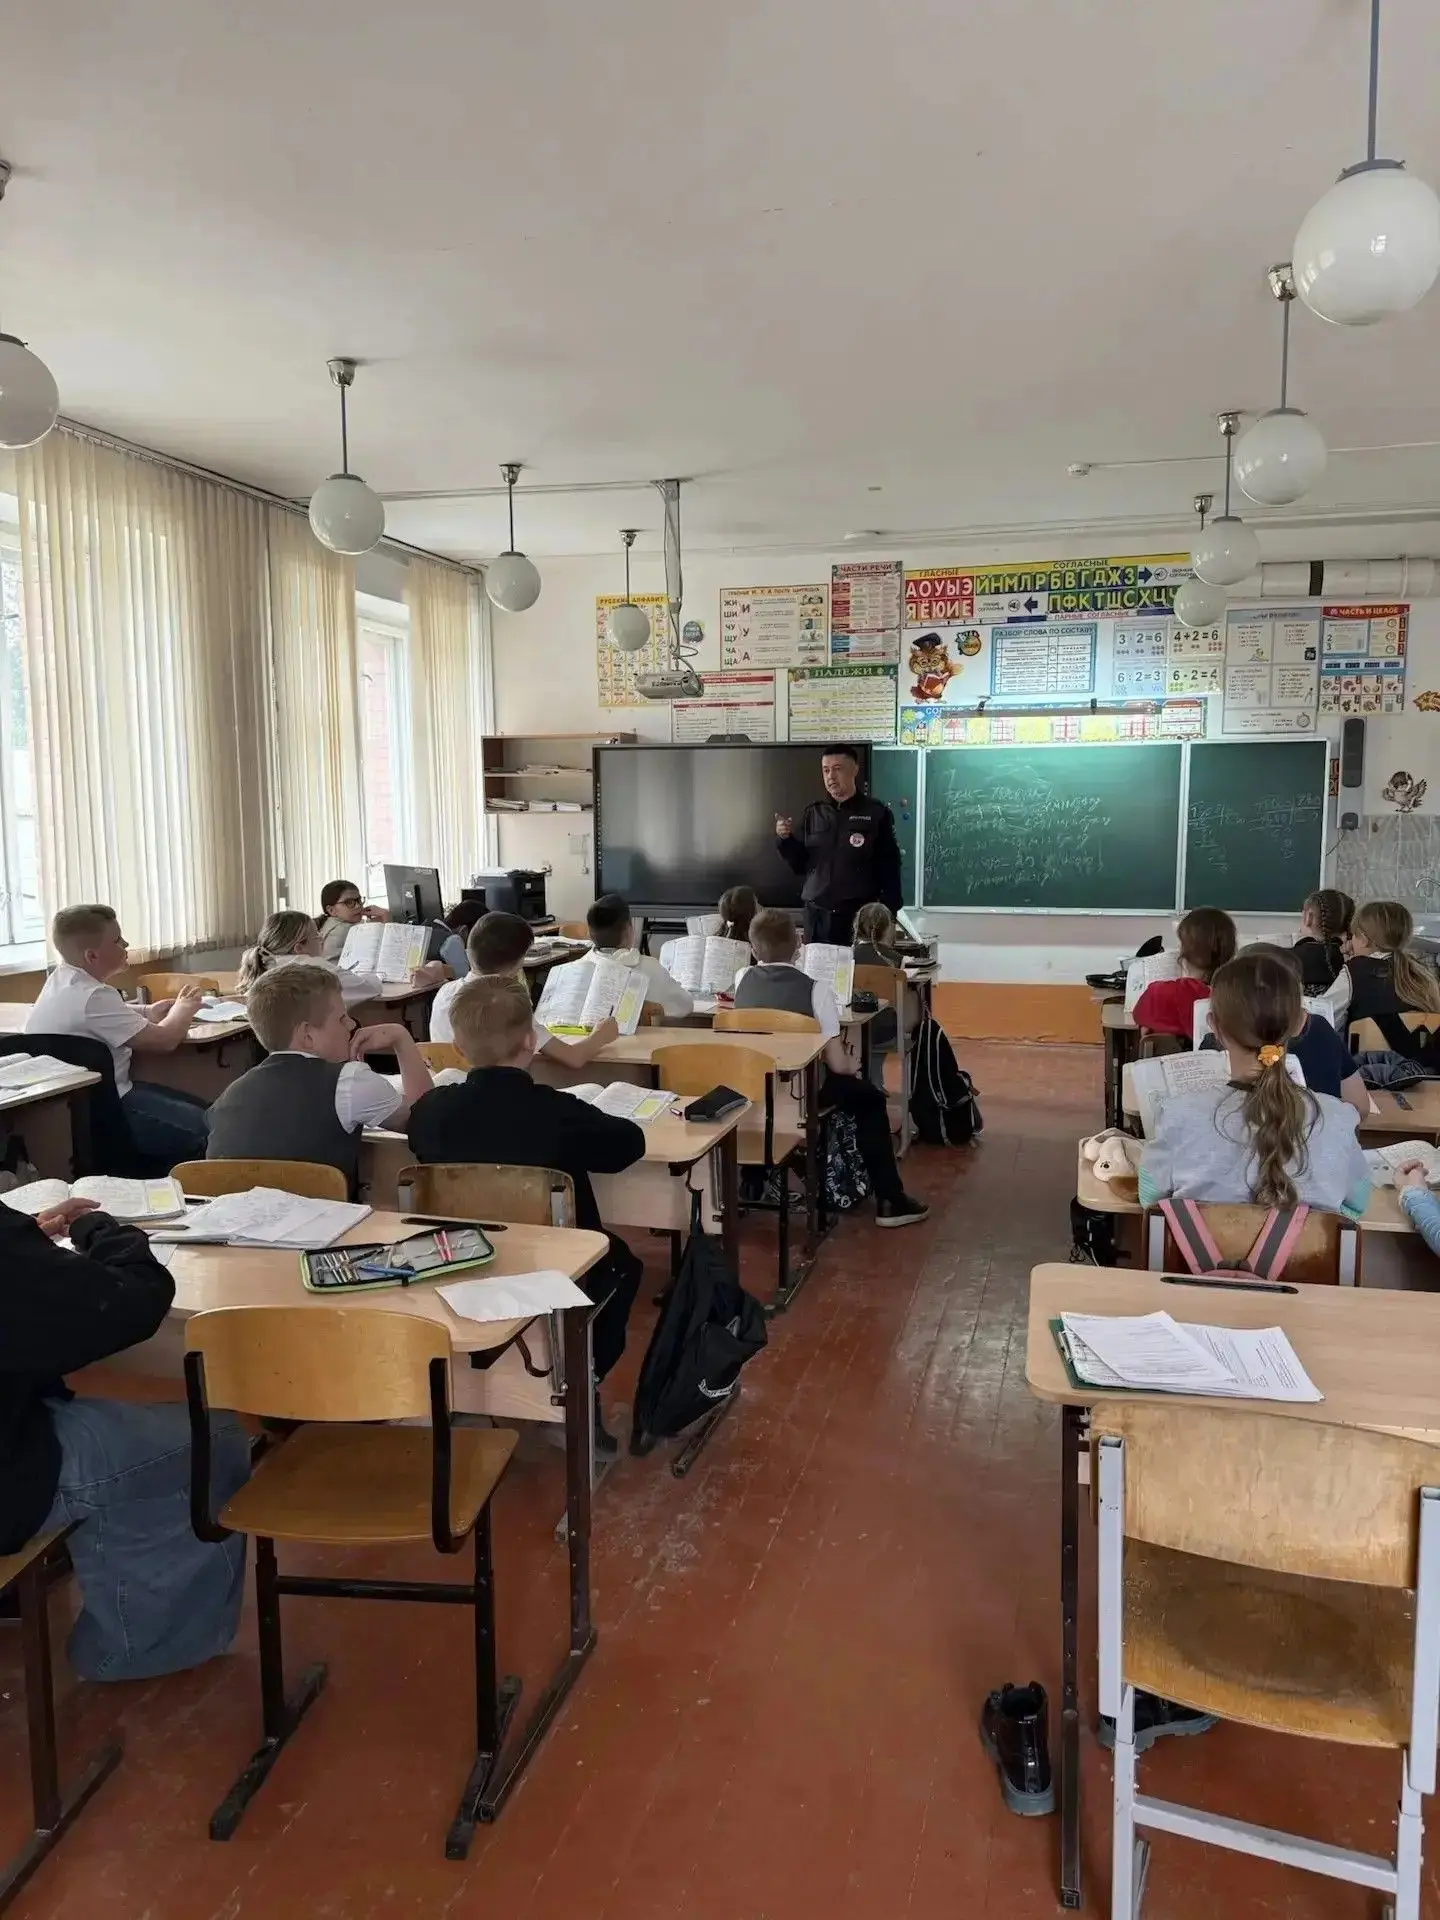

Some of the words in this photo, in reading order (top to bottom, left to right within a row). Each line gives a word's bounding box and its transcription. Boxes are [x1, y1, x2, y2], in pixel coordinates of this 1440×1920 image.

[1053, 559, 1108, 569] СОГЛАСНЫЕ
[919, 568, 960, 577] ГЛАСНЫЕ
[742, 604, 750, 613] И
[1340, 608, 1365, 616] ЧАСТЬ
[1373, 607, 1398, 615] ЦЕЛОЕ
[1087, 611, 1129, 619] СОГЛАСНЫЕ
[743, 628, 749, 637] У
[1174, 631, 1181, 642] 4
[1192, 630, 1199, 641] 2
[1211, 630, 1219, 640] 6
[1119, 634, 1126, 645] 3
[1136, 633, 1144, 643] 2
[1154, 632, 1162, 643] 6
[743, 652, 750, 660] А
[814, 667, 873, 677] ПАДЕЖИ
[1117, 672, 1125, 682] 6
[1135, 671, 1143, 681] 2
[1153, 671, 1160, 681] 3
[1173, 670, 1180, 681] 6
[1191, 670, 1198, 680] 2
[1210, 669, 1218, 679] 4
